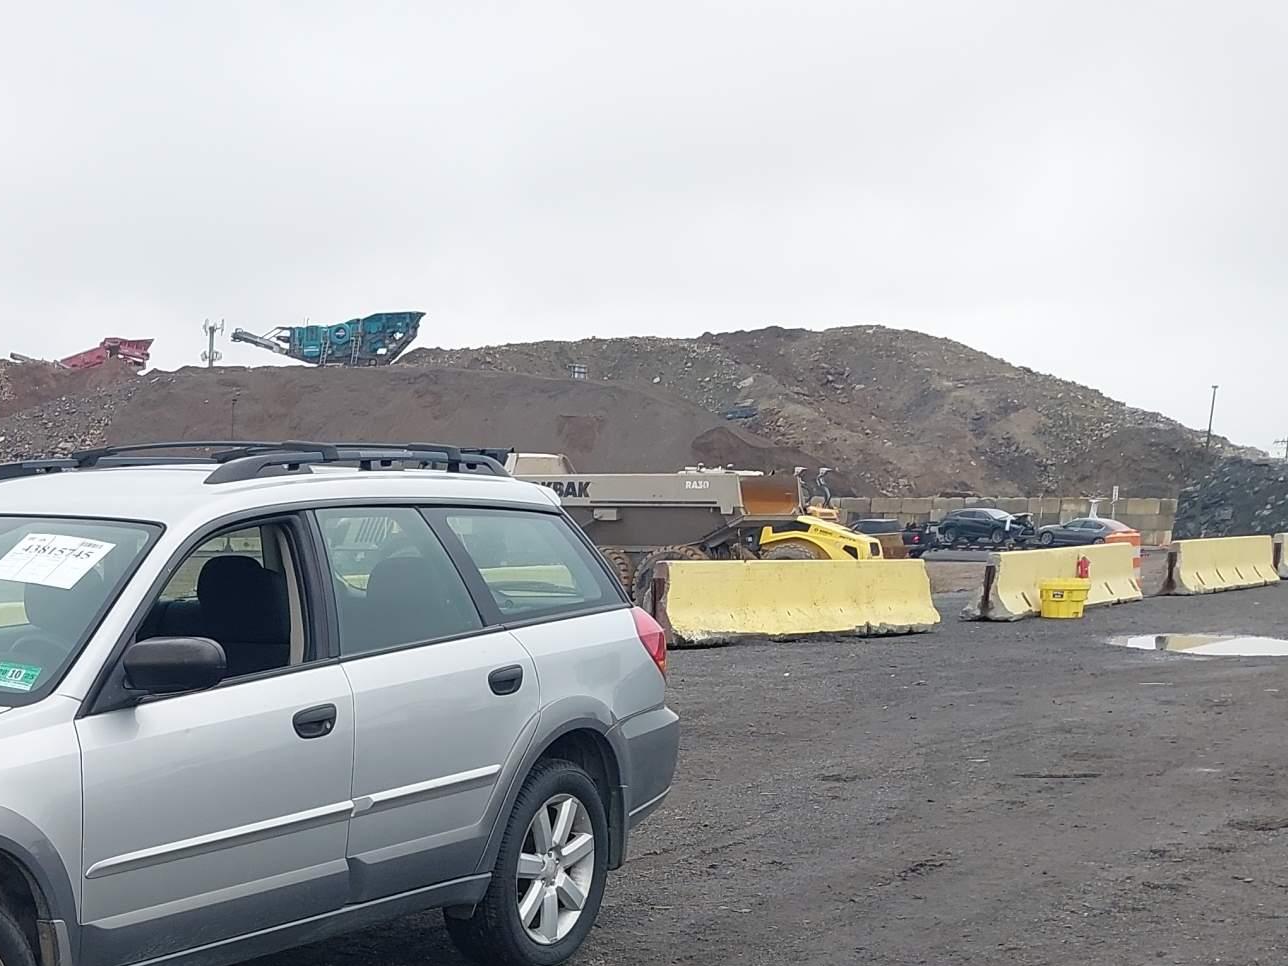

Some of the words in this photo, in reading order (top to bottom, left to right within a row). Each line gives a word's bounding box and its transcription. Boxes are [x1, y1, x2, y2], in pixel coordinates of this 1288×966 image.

[685, 480, 710, 489] RA30
[22, 543, 94, 560] 43815745
[8, 669, 22, 679] 10
